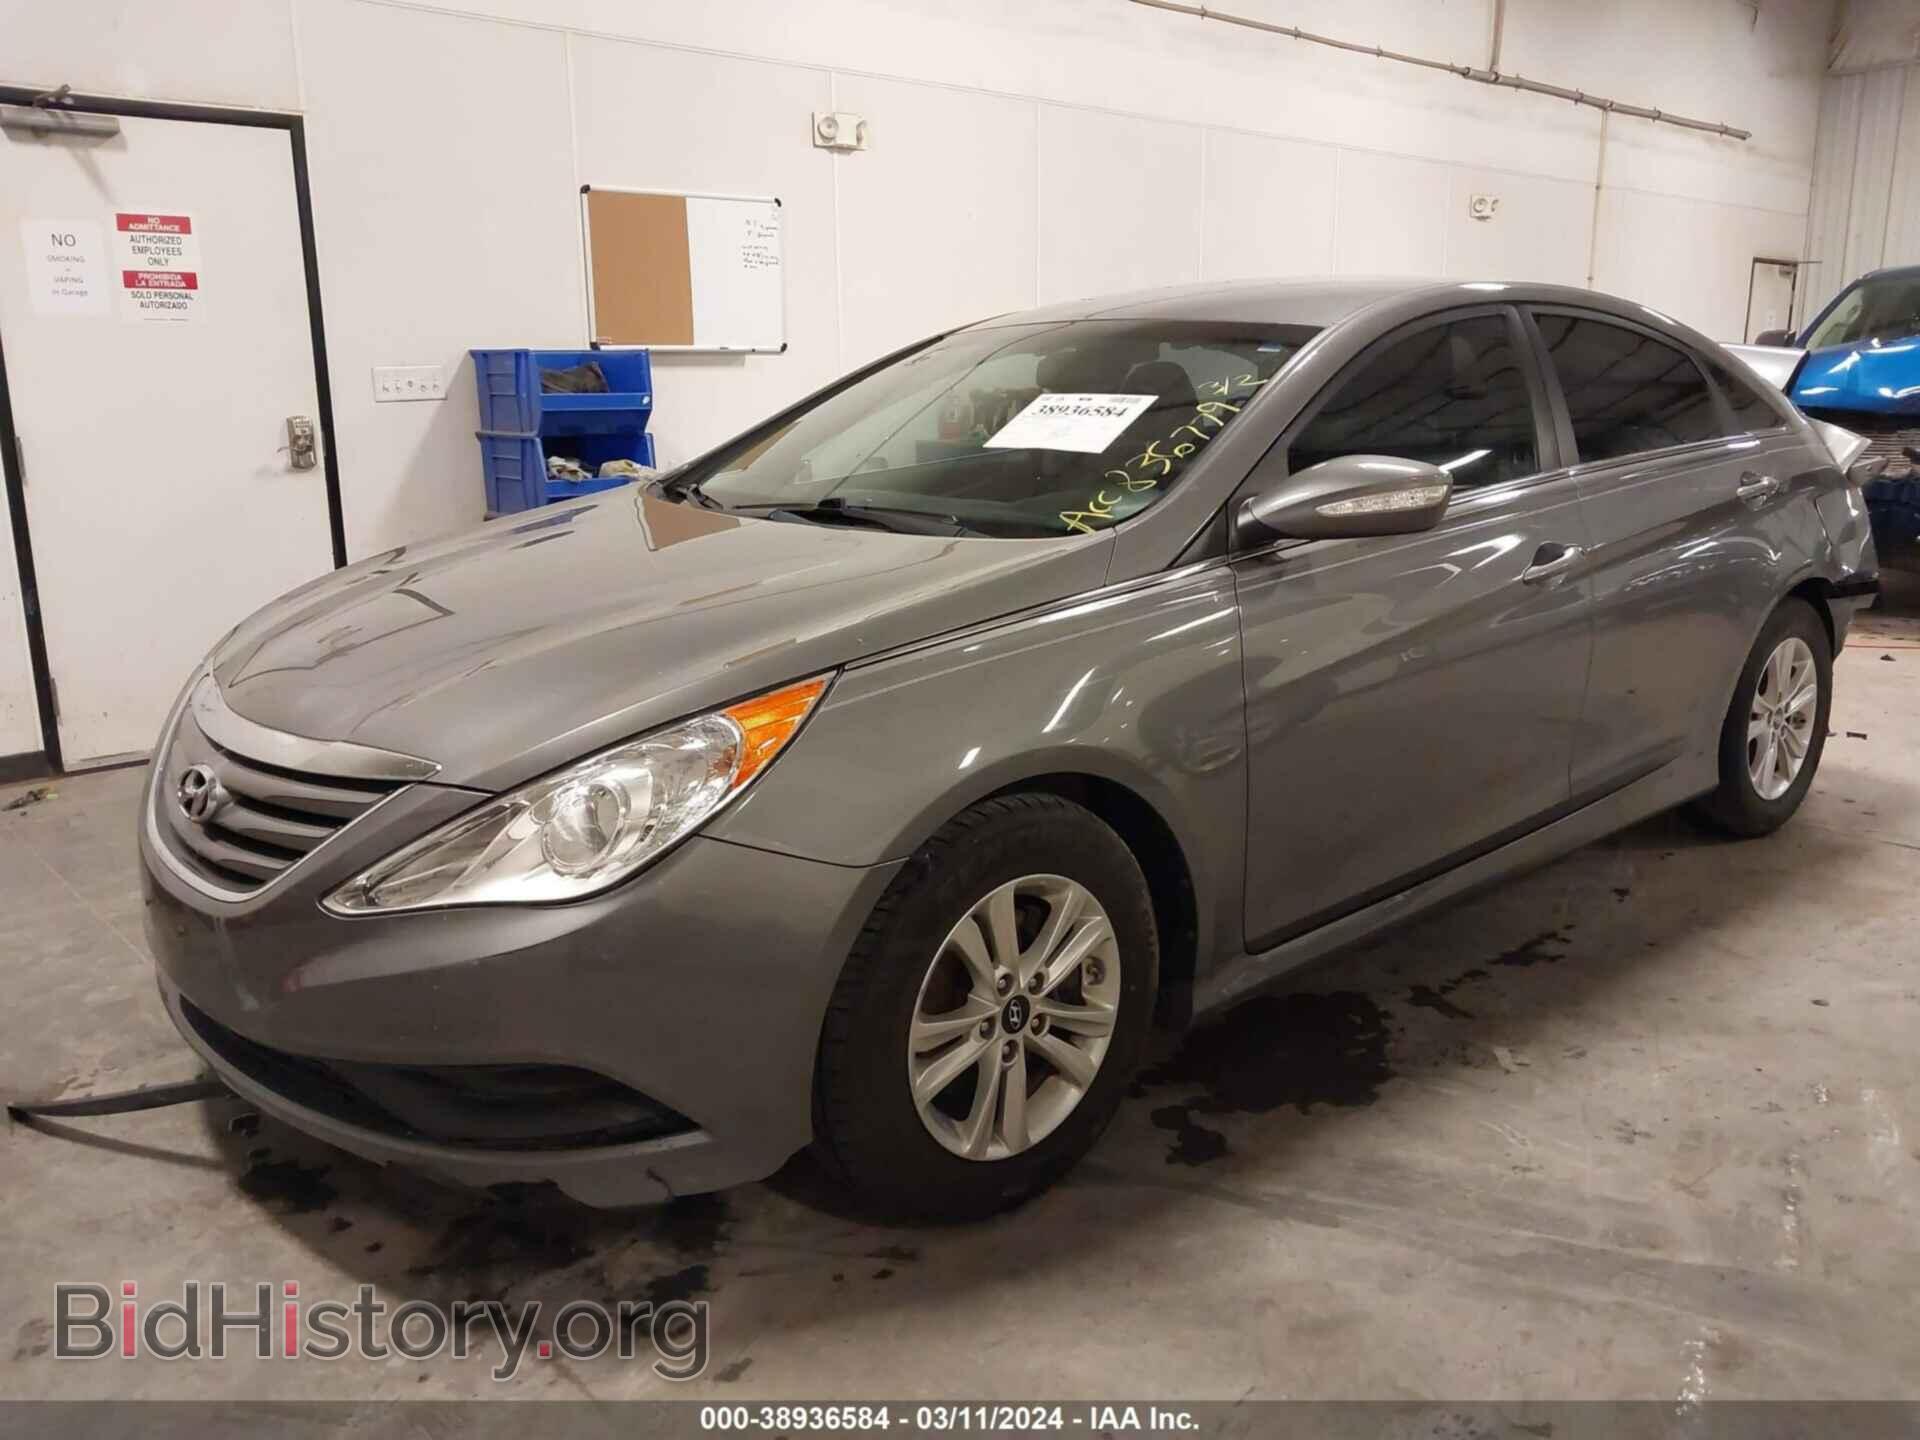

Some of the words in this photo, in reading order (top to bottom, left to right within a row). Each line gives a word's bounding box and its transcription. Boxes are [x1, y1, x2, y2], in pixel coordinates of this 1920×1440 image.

[148, 216, 160, 225] NO
[128, 223, 180, 232] ADMITTANCE
[51, 234, 76, 247] NO
[129, 235, 182, 246] AUTHORIZED
[132, 247, 182, 257] EMPLOYEES
[47, 255, 86, 263] SMOKING
[147, 257, 169, 266] ONLY
[135, 280, 147, 288] LA
[148, 280, 187, 288] ENTRADA
[131, 291, 152, 300] SOLO
[153, 291, 194, 301] PERSONAL
[139, 301, 188, 310] AUTORIZADO
[1033, 405, 1129, 417] 38936584
